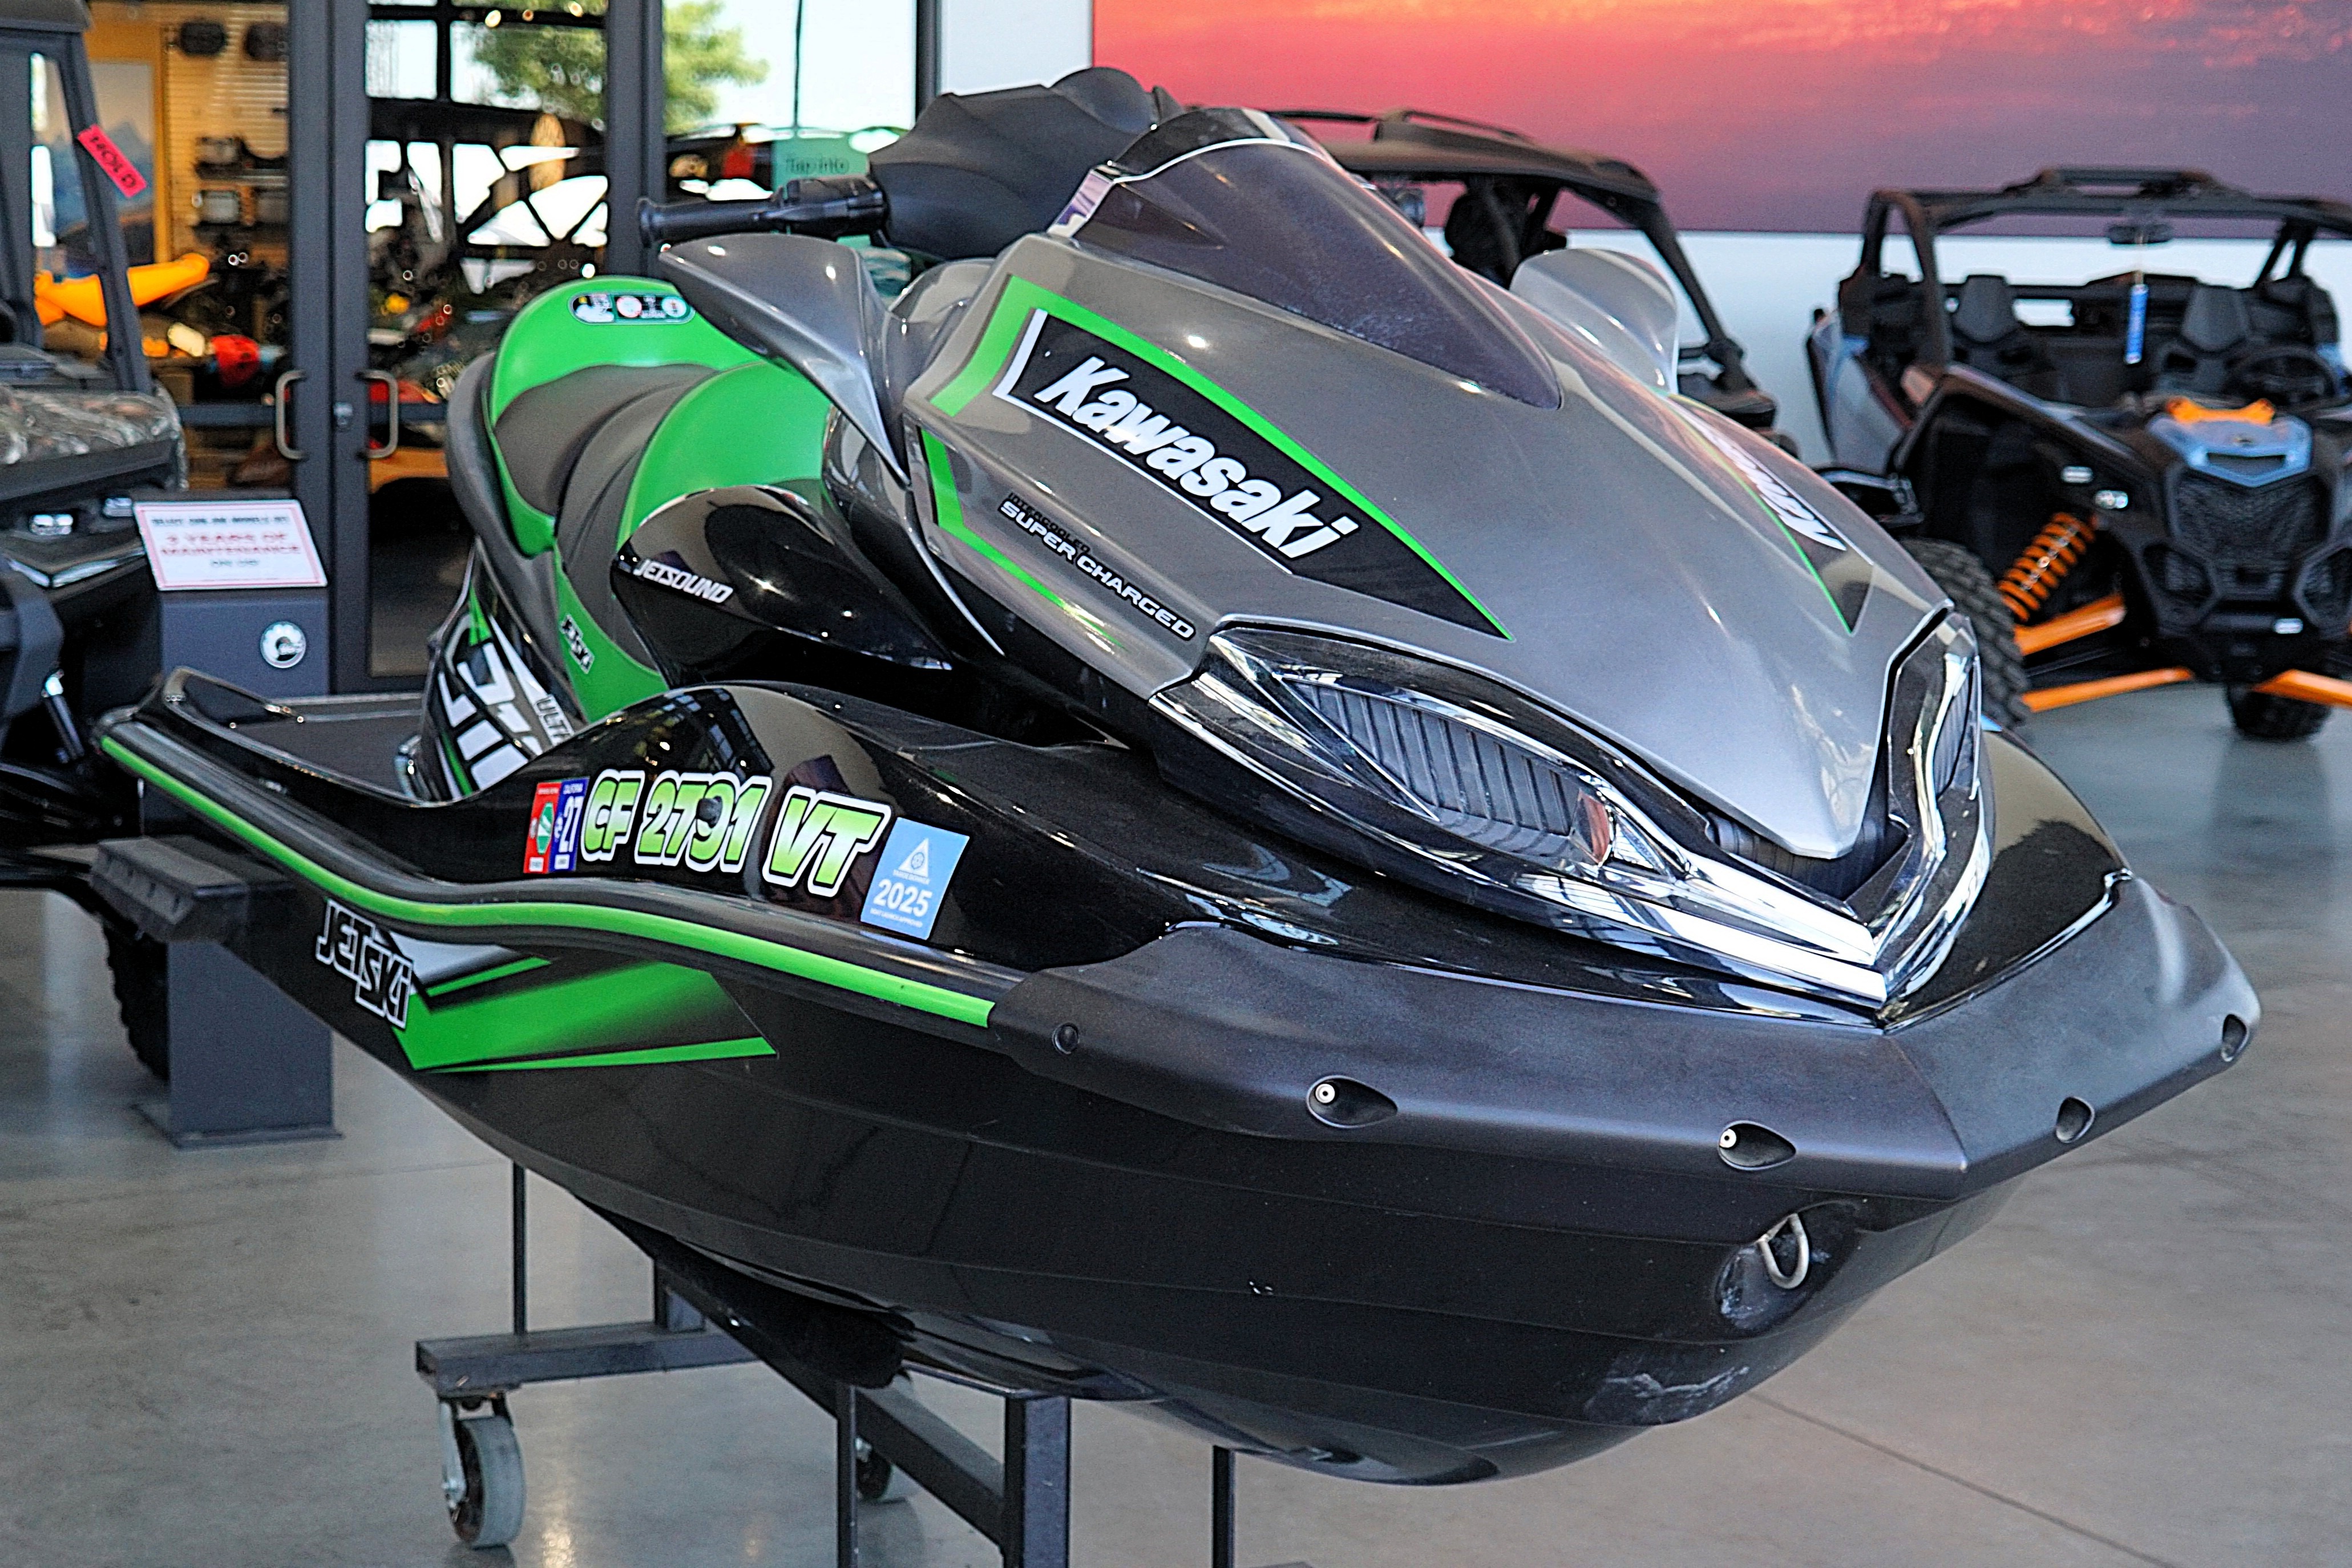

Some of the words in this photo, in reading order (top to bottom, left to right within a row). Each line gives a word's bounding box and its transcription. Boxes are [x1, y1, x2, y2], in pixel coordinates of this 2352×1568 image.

[1034, 356, 1359, 559] Kawasaki
[1008, 492, 1091, 553] INTERCOOLED
[633, 559, 734, 604] JETSOUND
[1000, 500, 1077, 561] SUPER
[1076, 555, 1195, 639] CHARGED
[558, 795, 585, 852] 27
[581, 770, 644, 860] CF
[636, 773, 770, 871] 2791
[764, 787, 890, 895] VT
[872, 878, 933, 918] 2025
